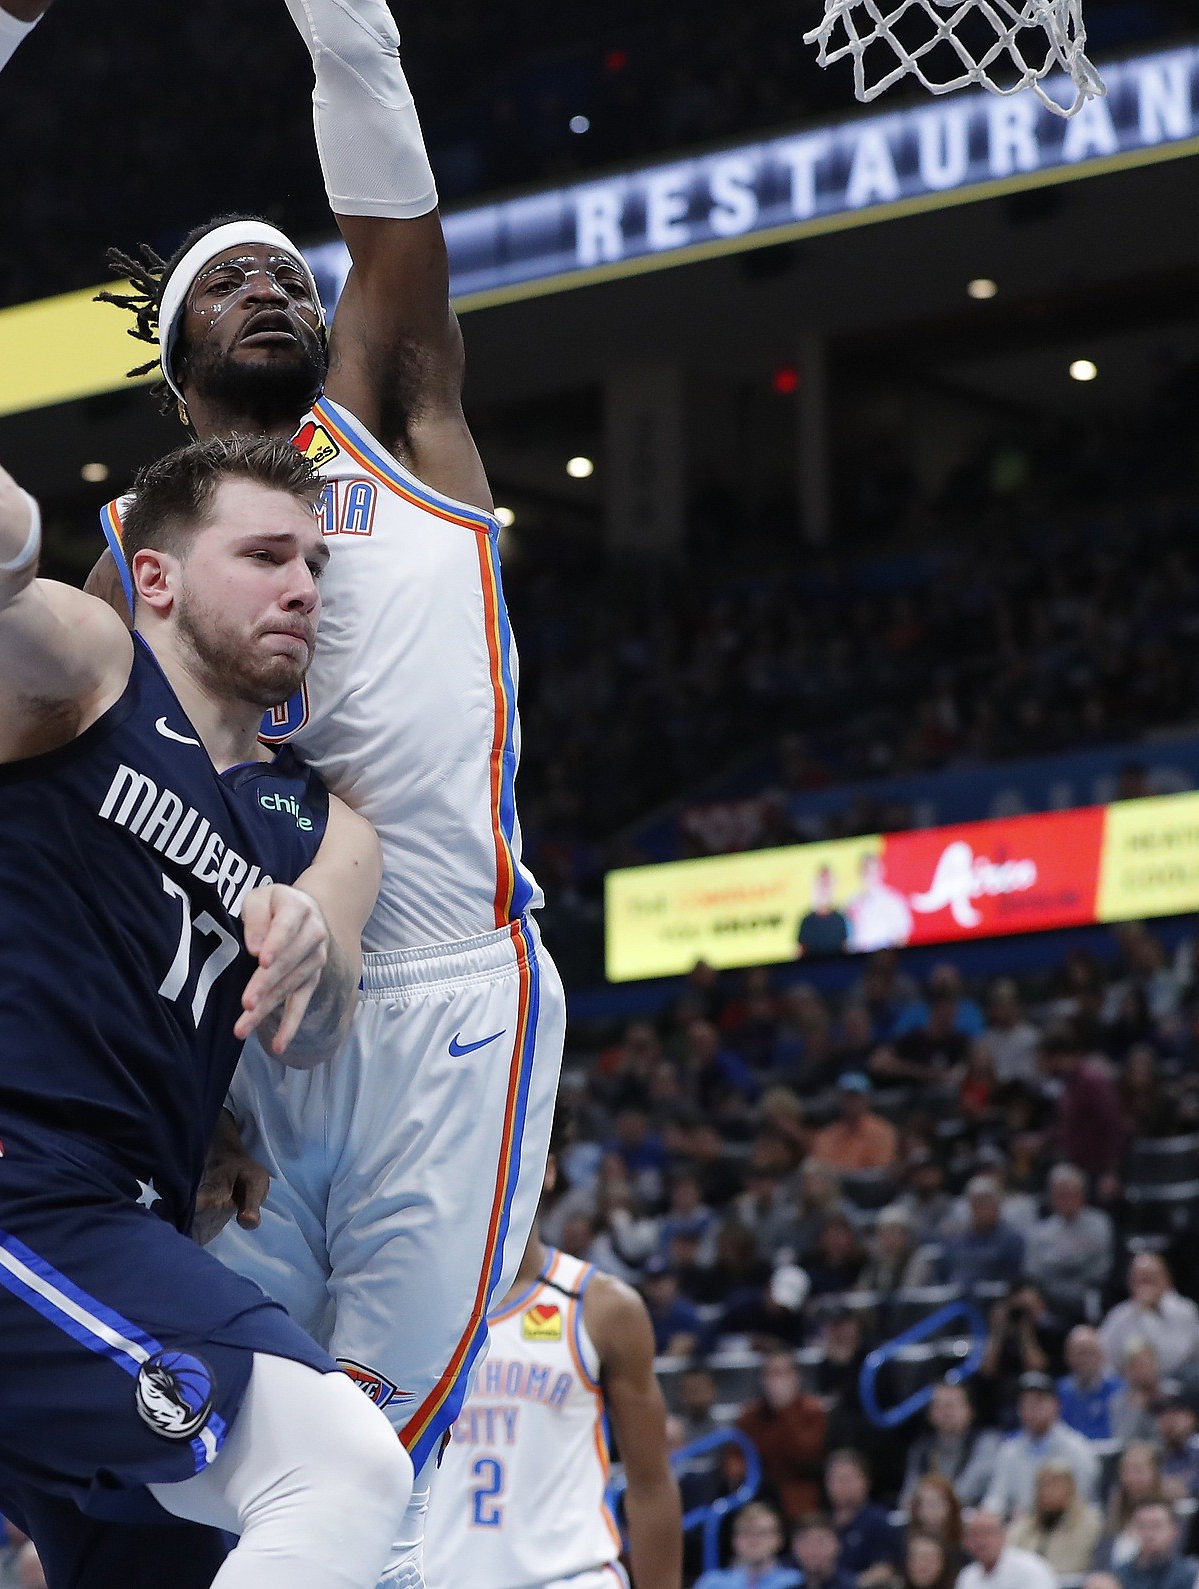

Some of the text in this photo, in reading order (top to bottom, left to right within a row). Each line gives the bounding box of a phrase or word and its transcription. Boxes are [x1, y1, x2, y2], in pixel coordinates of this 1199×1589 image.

[98, 763, 275, 919] MAVERI
[157, 872, 241, 1030] 77
[452, 1404, 521, 1447] CITY
[468, 1455, 505, 1529] 2
